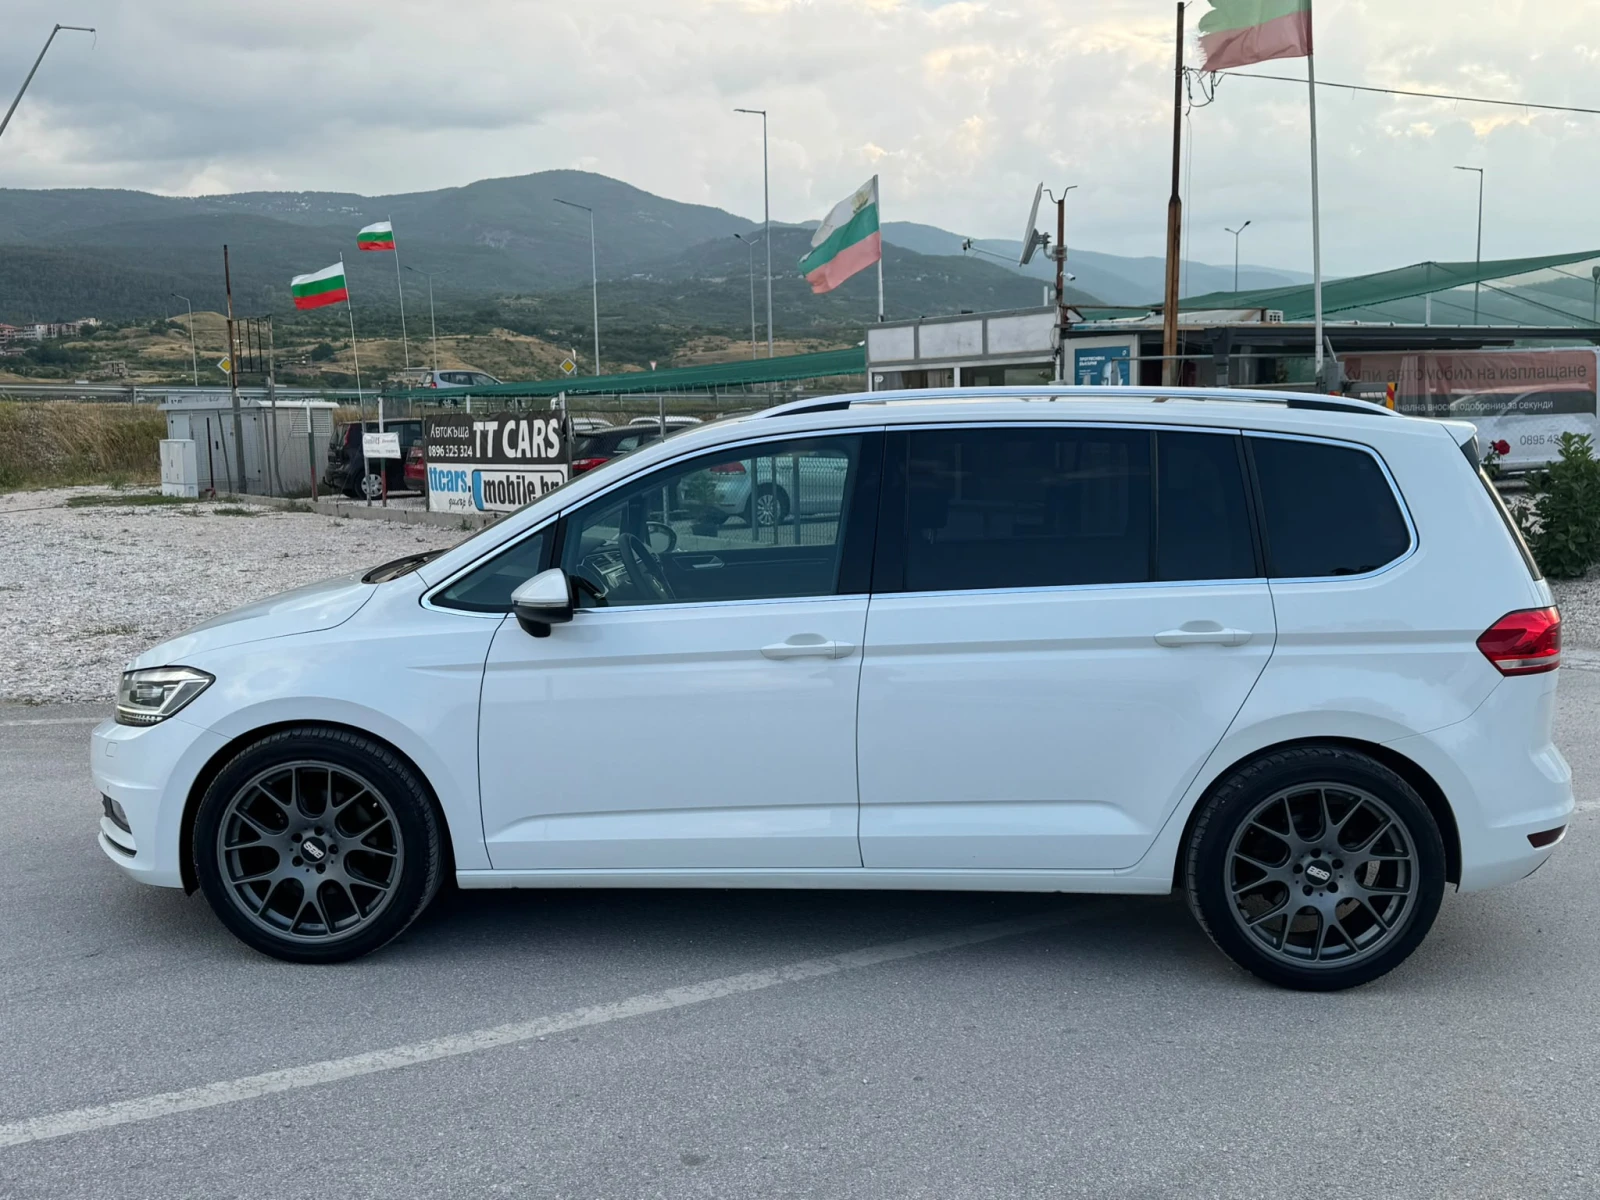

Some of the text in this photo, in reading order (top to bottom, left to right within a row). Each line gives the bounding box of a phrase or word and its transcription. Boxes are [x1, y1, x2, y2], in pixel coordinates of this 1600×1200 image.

[1387, 364, 1472, 381] автомобил
[1477, 367, 1496, 380] на
[1500, 364, 1586, 381] изплащане
[1459, 400, 1506, 412] одобрение
[1519, 400, 1554, 410] секунди
[430, 423, 469, 440] Автокъща
[473, 418, 560, 458] TT CARS
[1519, 434, 1545, 446] 0895
[428, 445, 473, 457] 0896 325 324
[429, 467, 560, 505] ttcars. mobileb
[303, 840, 325, 859] BBS
[1306, 865, 1330, 881] BBS
